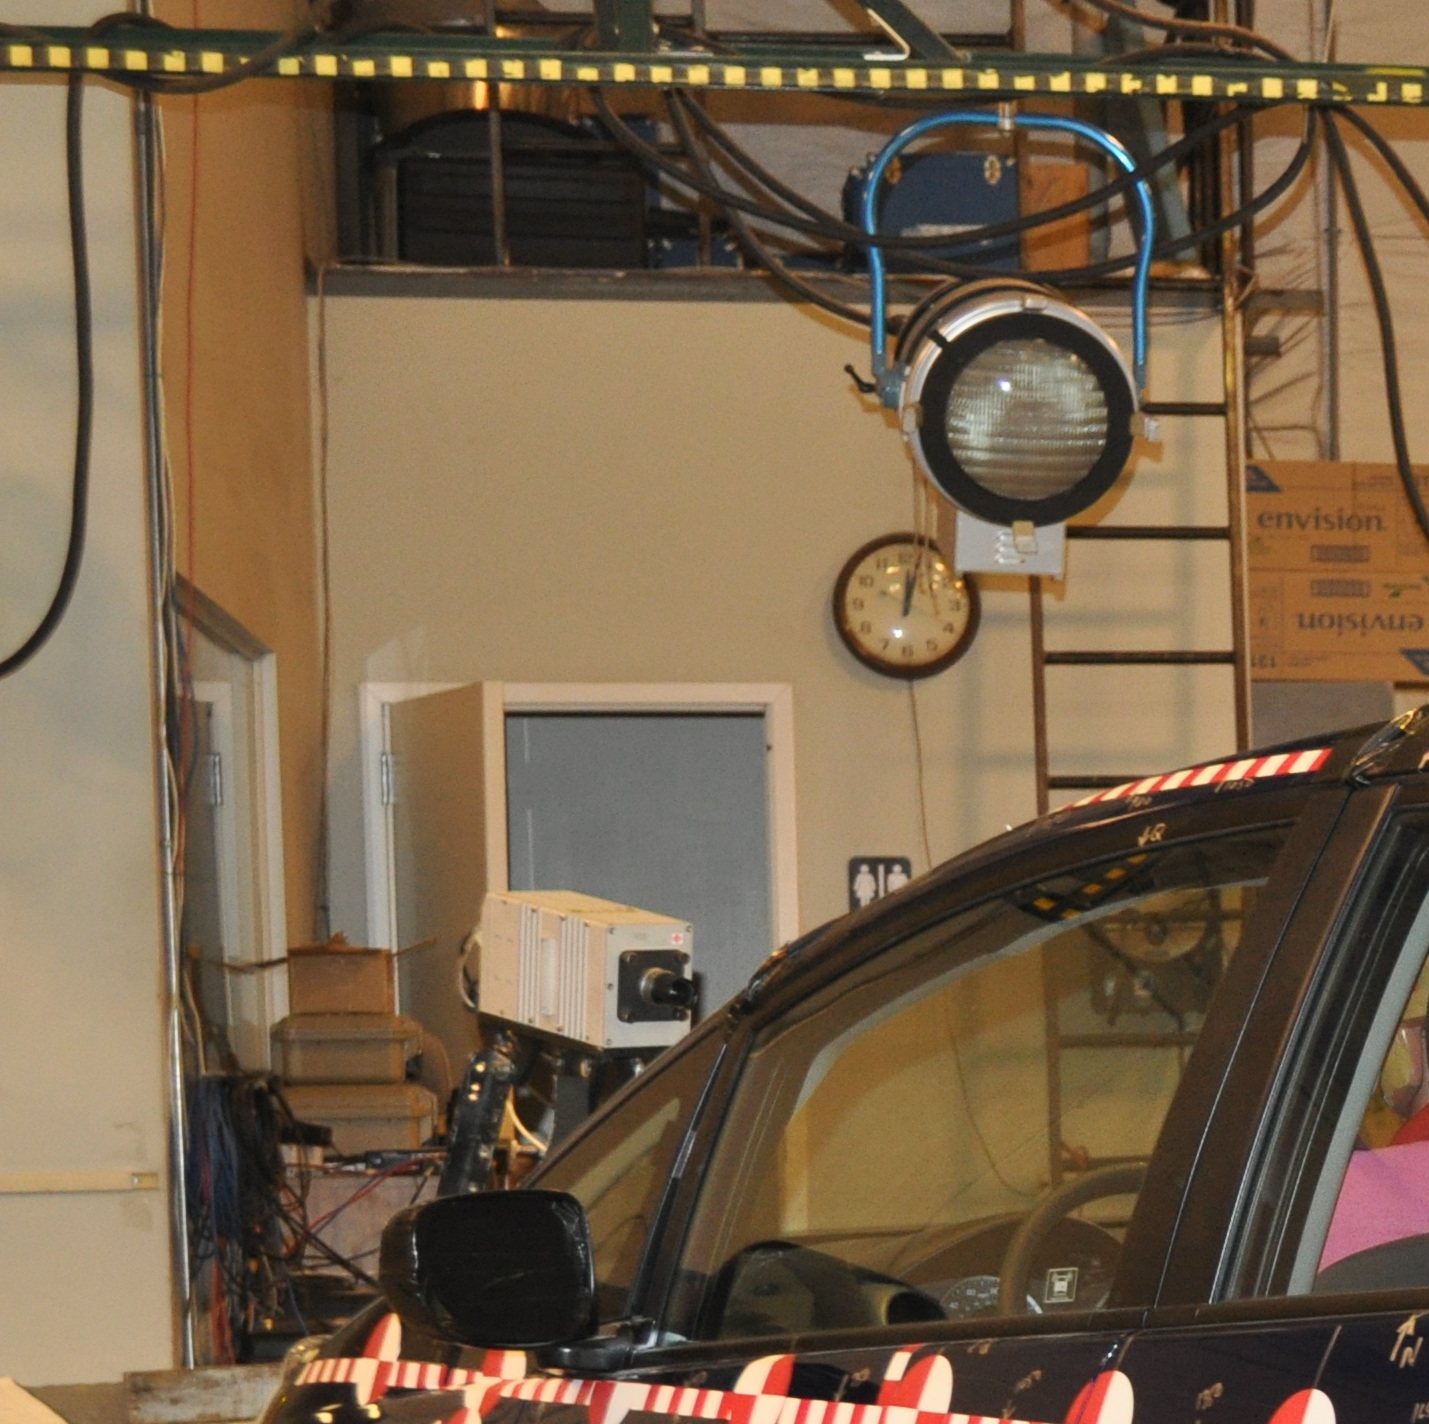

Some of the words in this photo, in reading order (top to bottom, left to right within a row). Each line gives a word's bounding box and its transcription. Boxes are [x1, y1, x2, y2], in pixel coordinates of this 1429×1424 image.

[1256, 508, 1382, 532] envision
[942, 622, 955, 635] 4
[1297, 612, 1425, 637] envision
[901, 644, 914, 657] 6
[926, 639, 938, 652] 5
